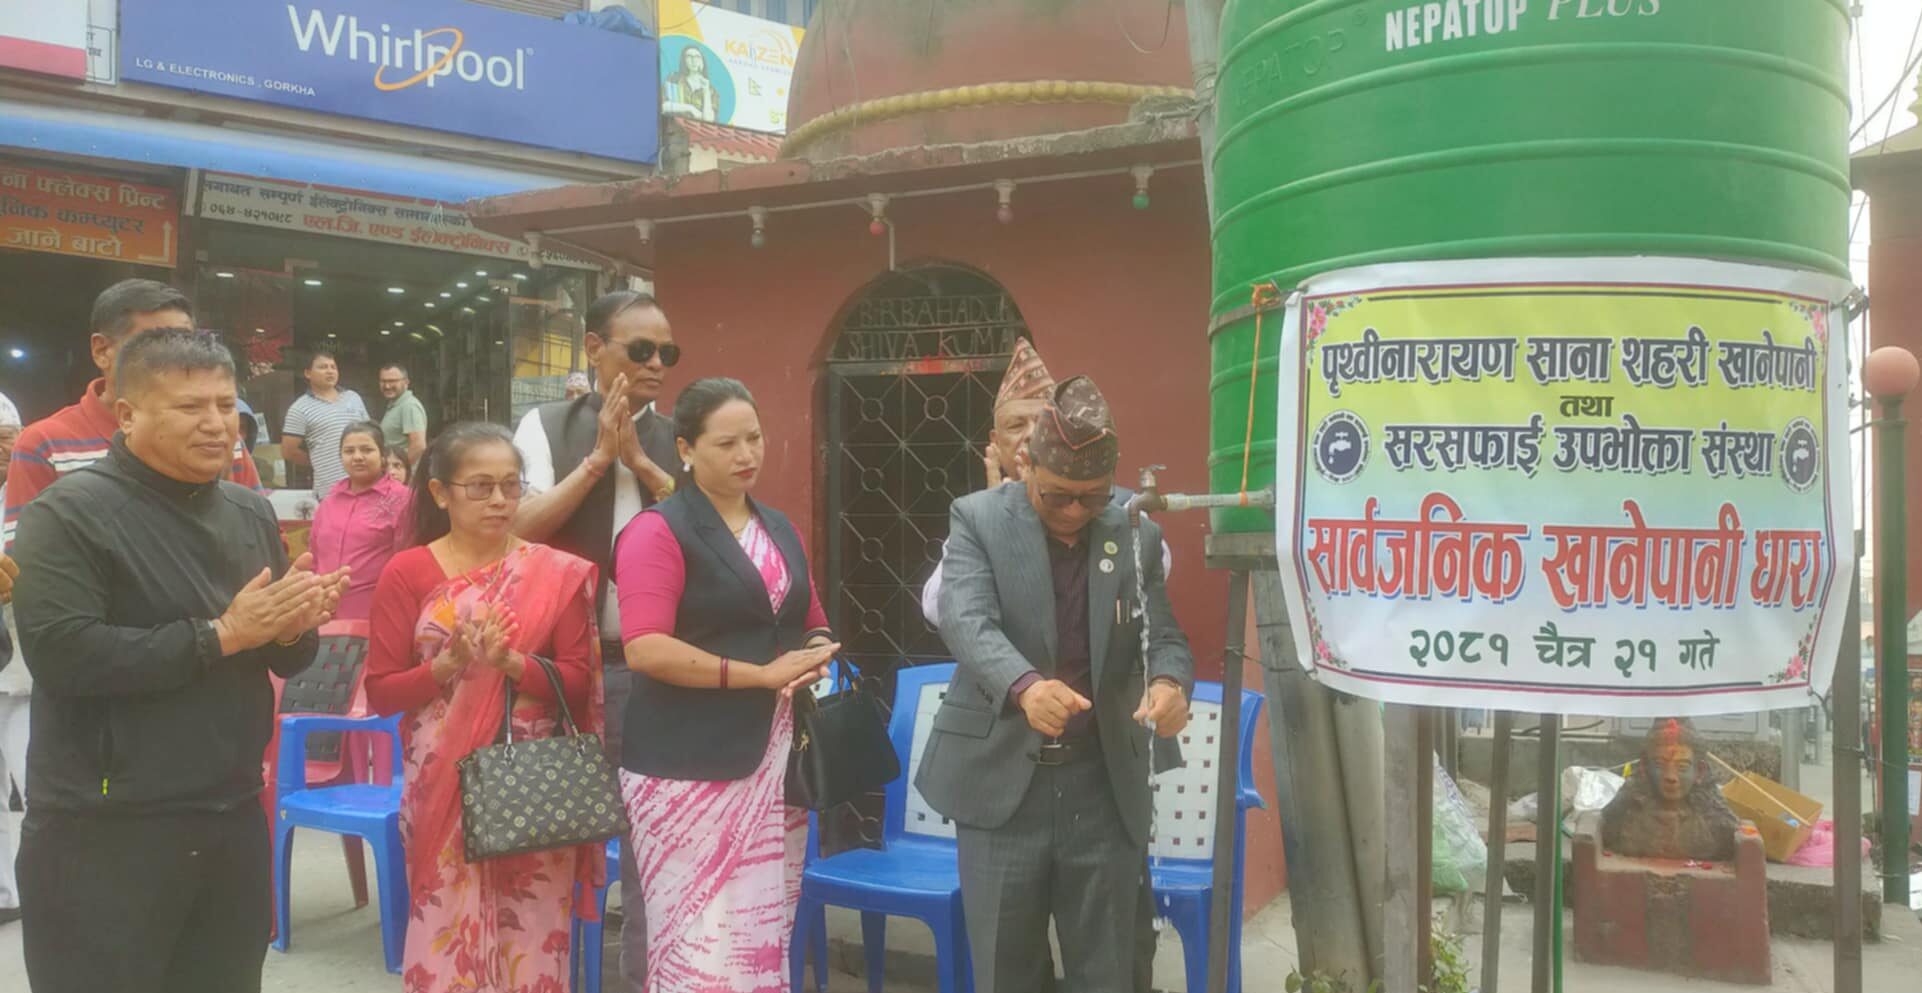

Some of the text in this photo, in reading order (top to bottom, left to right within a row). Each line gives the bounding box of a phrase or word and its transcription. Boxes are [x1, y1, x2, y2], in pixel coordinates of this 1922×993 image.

[288, 4, 525, 90] Whirlpool
[1385, 0, 1528, 51] NEPATOP
[136, 57, 153, 69] LG
[156, 61, 165, 71] &
[169, 63, 255, 86] ELECTRONICS
[264, 79, 316, 97] GORKHA
[1322, 326, 1817, 394] पृथ्वीनारायण साना शहरी खानेपानी
[1559, 395, 1614, 417] तथा
[1384, 414, 1543, 474] सरसफाई
[1552, 414, 1693, 472] उपभोक्ता
[1701, 421, 1775, 475] संस्था
[1308, 493, 1823, 611] सार्वजनिक खानेपानी धारा
[1410, 621, 1720, 677] २०८१ चैत्र २१ गते
